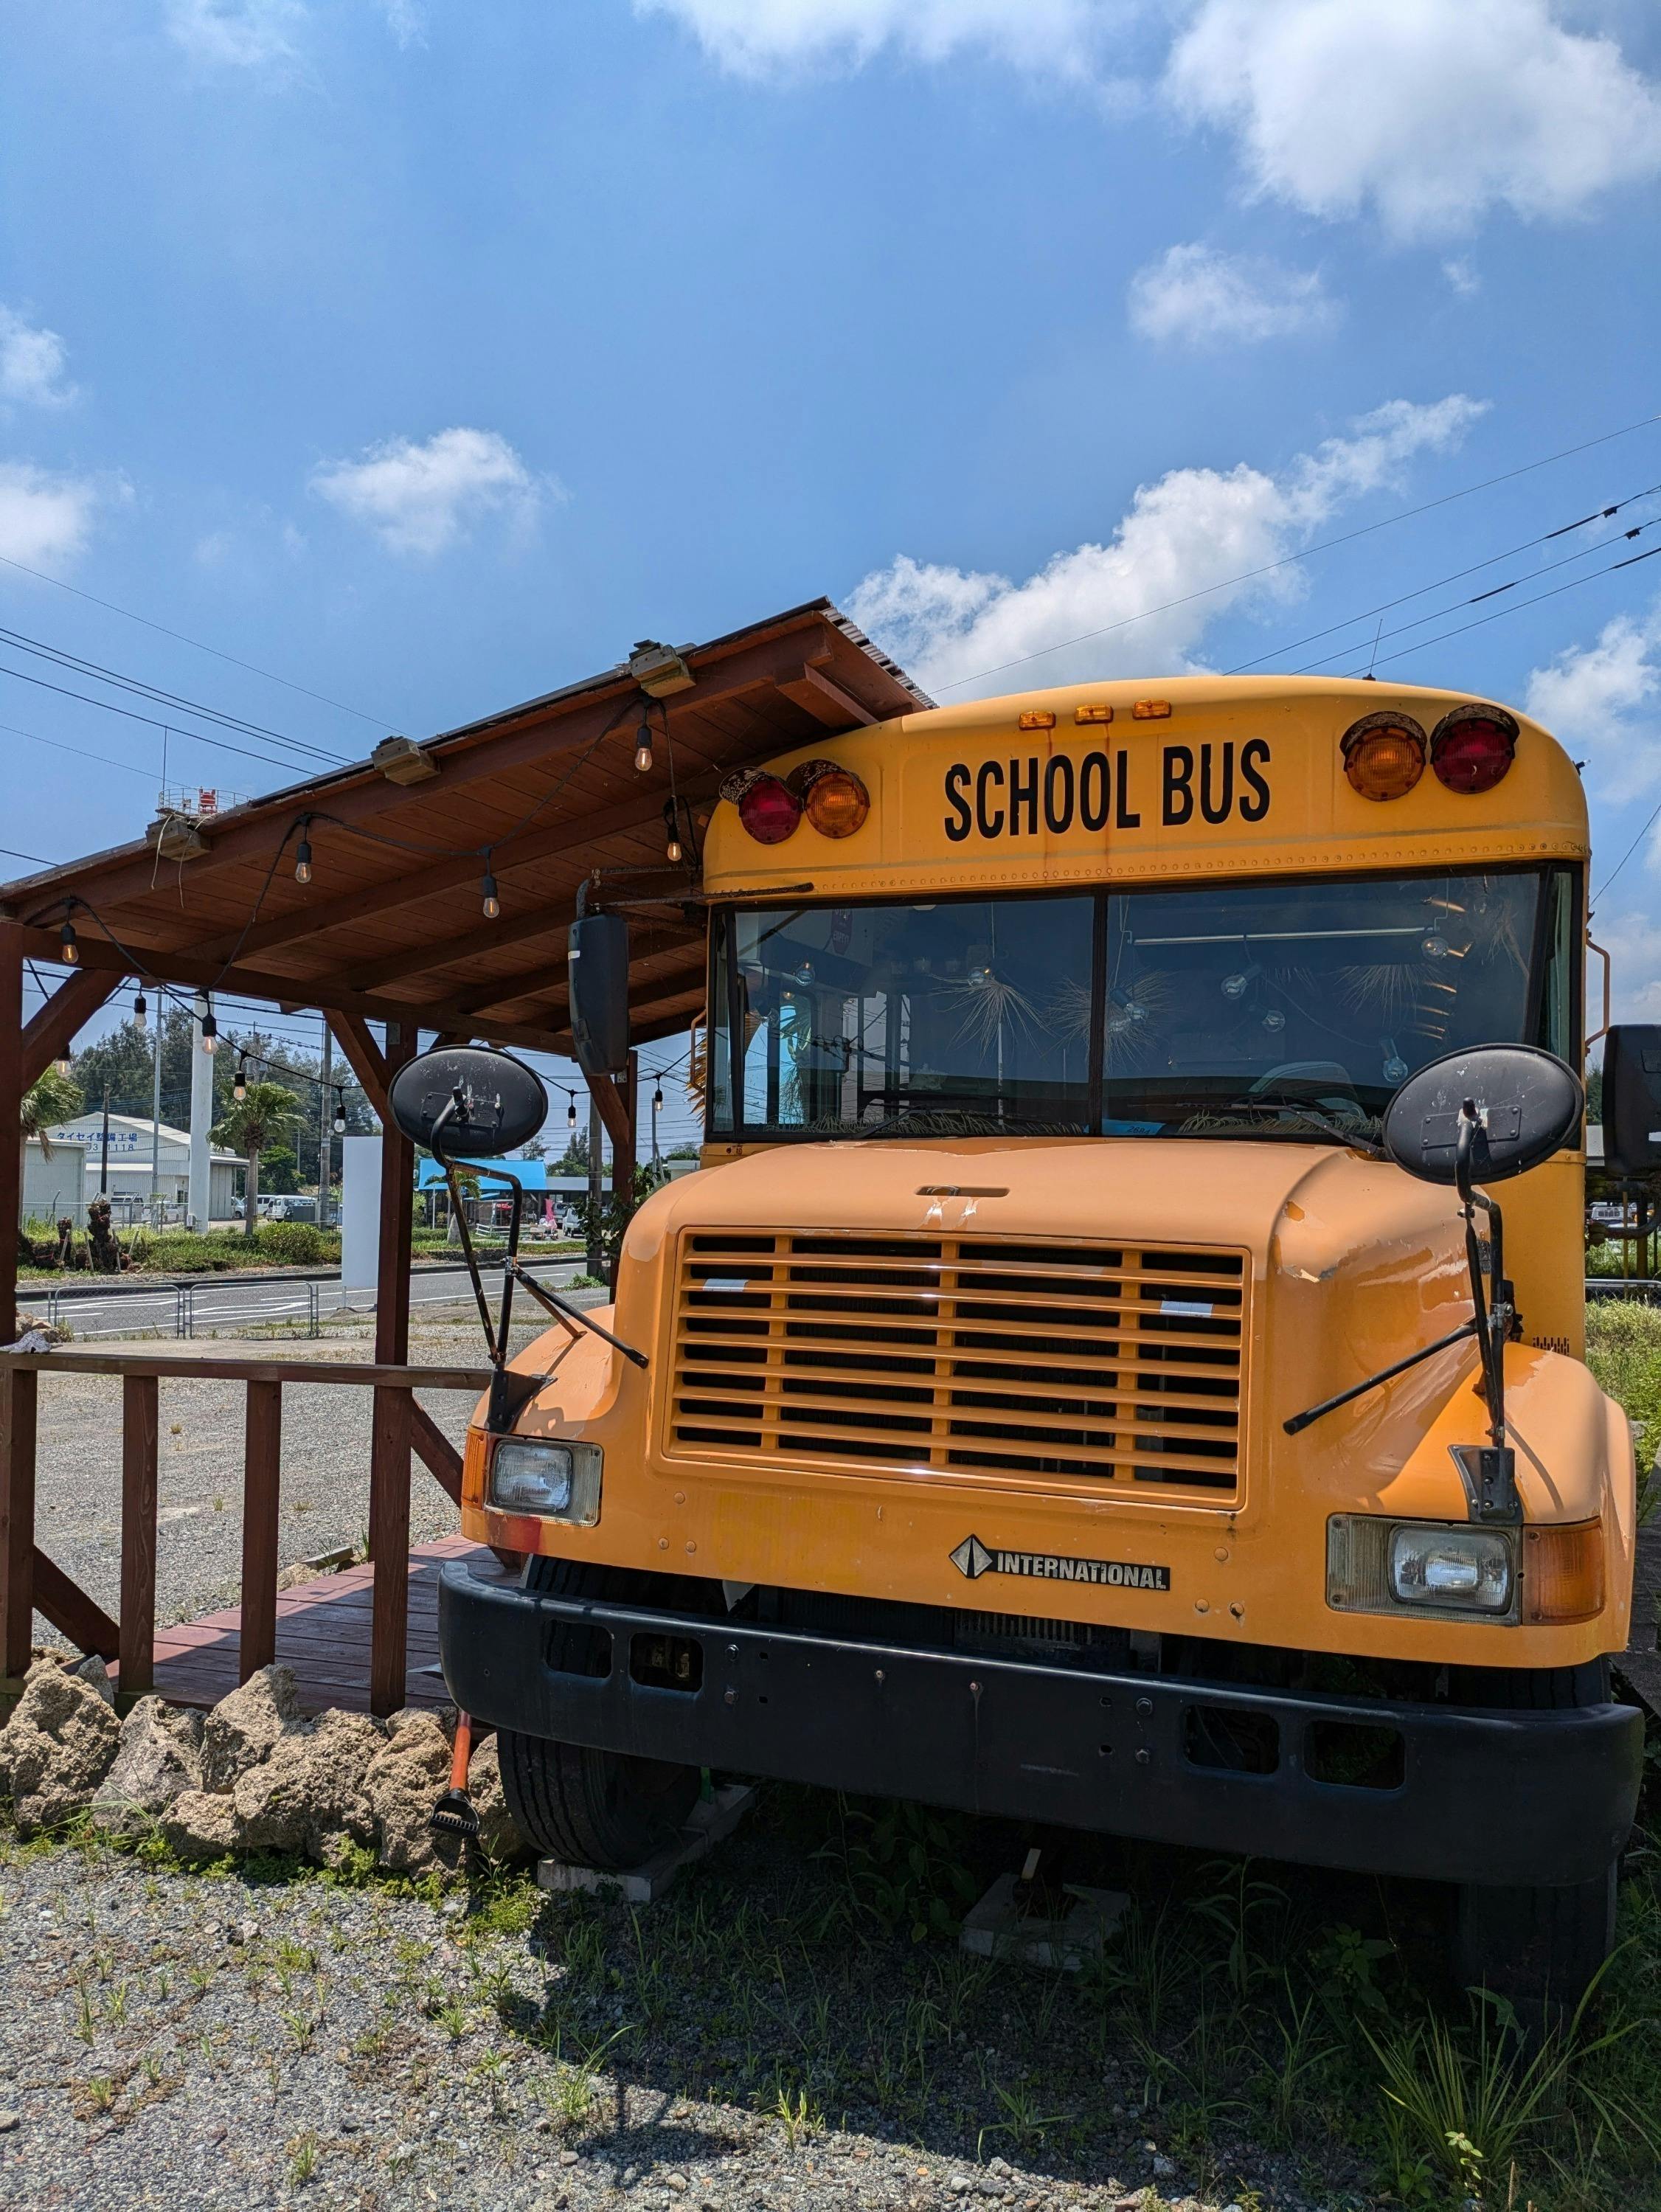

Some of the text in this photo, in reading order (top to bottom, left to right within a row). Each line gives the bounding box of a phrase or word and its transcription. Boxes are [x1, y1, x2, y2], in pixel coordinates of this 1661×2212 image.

[944, 738, 1271, 842] SCHOOL BUS
[997, 1552, 1166, 1589] INTERNATIONAL
